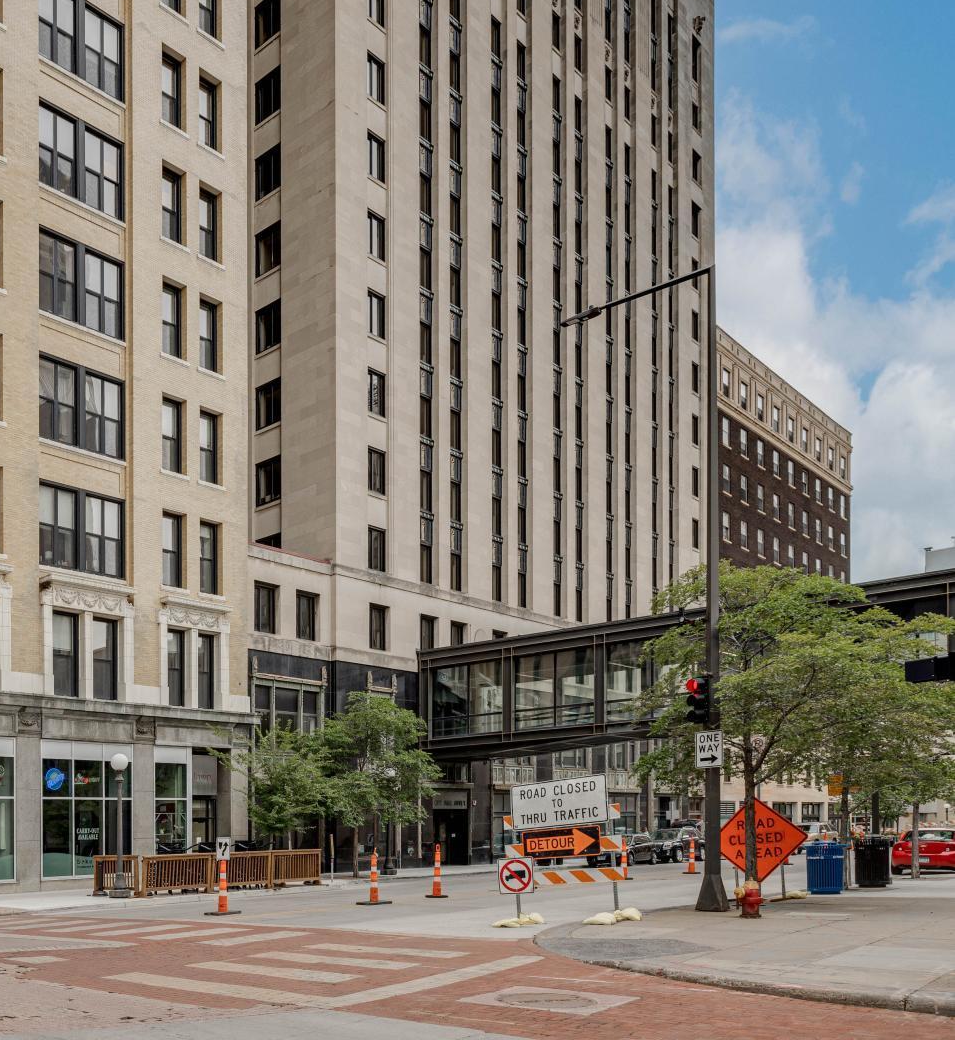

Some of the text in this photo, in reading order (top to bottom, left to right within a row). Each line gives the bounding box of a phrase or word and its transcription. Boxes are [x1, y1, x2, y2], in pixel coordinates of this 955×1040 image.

[699, 734, 719, 743] ONE
[698, 744, 720, 753] WAY
[520, 780, 596, 800] ROAD CLOSED
[552, 798, 563, 808] TO
[521, 806, 599, 824] THRU TRAFFIC
[736, 817, 775, 830] RAD
[529, 837, 575, 850] DETOUR
[728, 832, 783, 846] CLSED
[735, 846, 783, 860] AEAD
